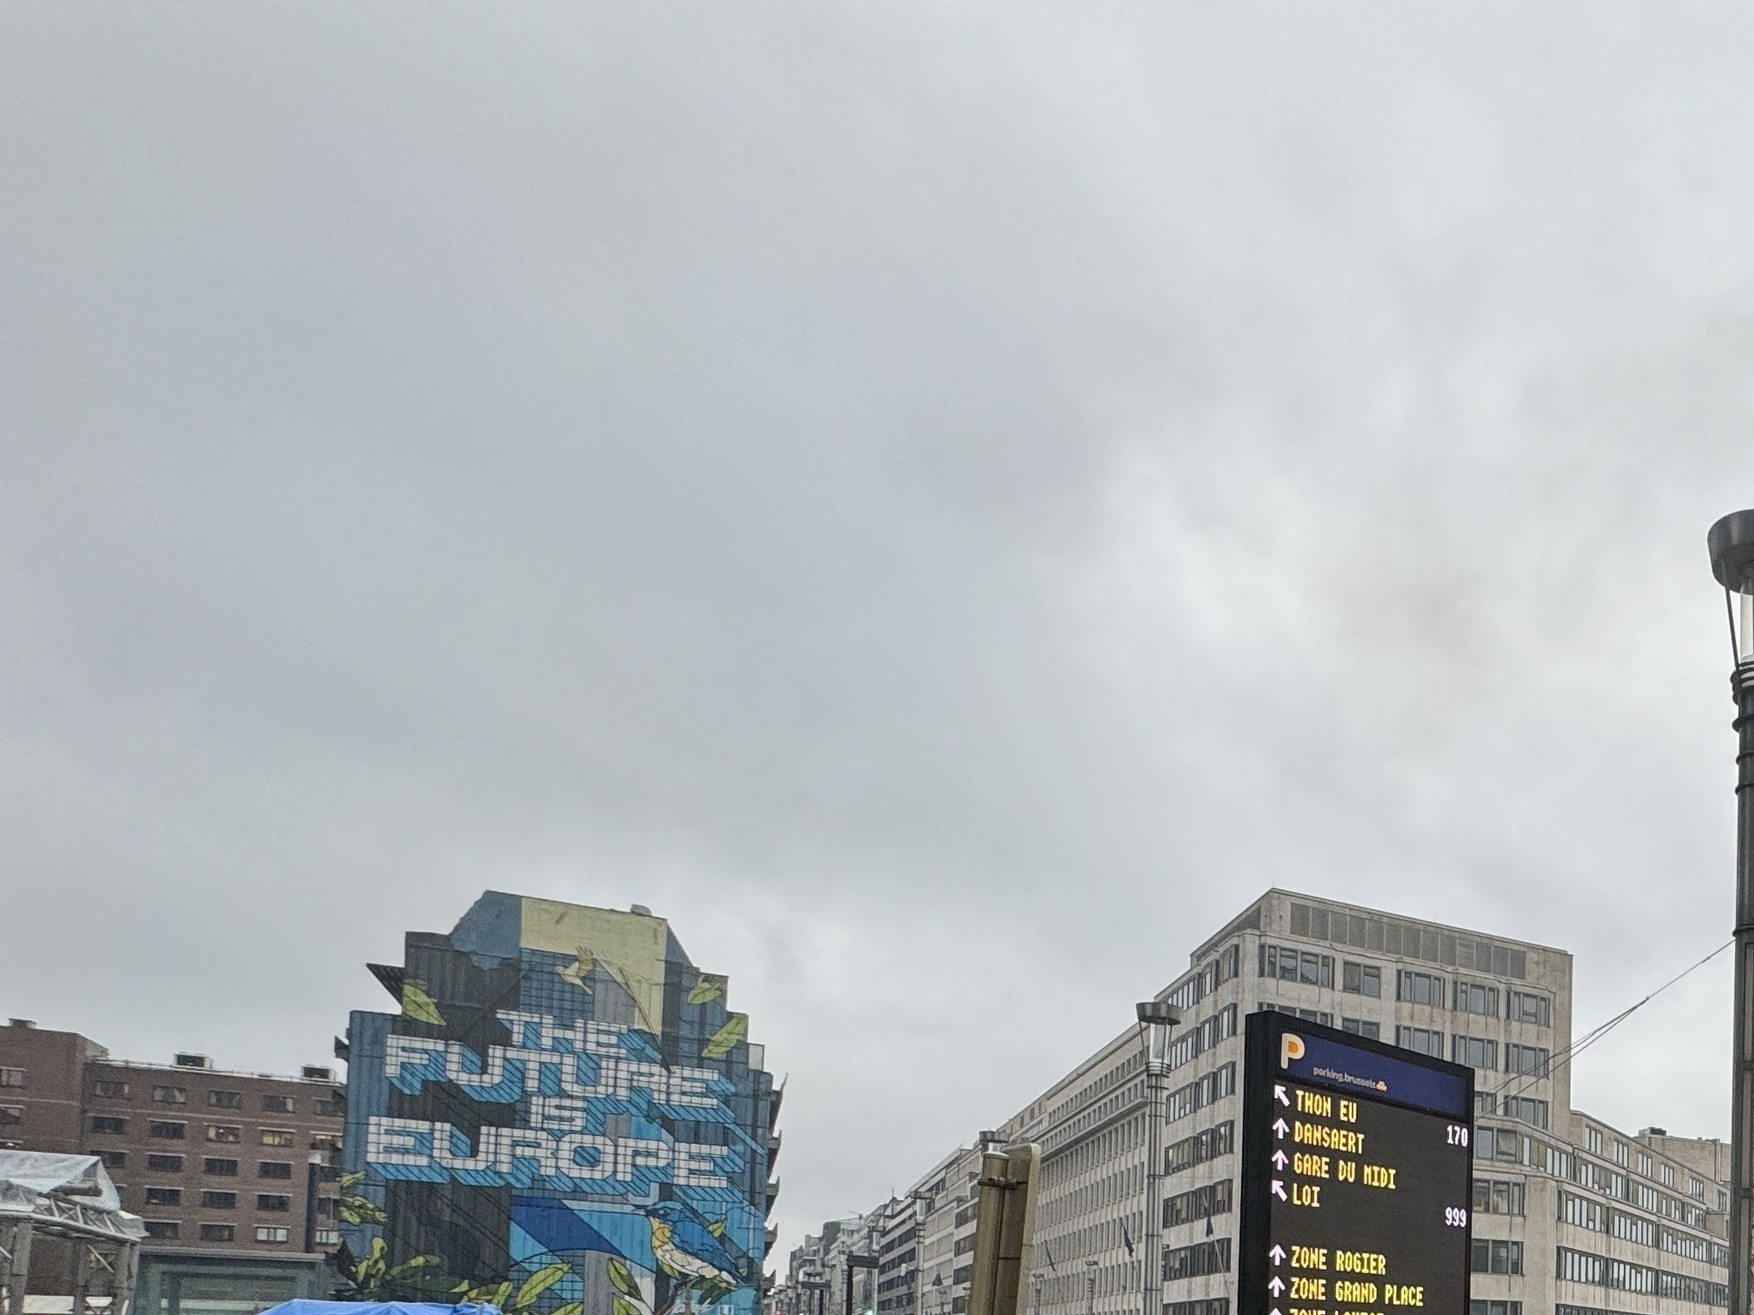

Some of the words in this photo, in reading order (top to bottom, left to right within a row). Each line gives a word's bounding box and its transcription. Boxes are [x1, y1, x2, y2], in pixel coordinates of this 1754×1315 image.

[496, 1009, 628, 1057] THE
[1281, 1033, 1305, 1069] P
[385, 1035, 719, 1108] FUTURE
[530, 1096, 587, 1131] IS
[1296, 1090, 1331, 1117] THON
[1340, 1100, 1357, 1123] EU
[1447, 1125, 1468, 1147] 170
[366, 1116, 728, 1187] EUROPE
[1295, 1121, 1364, 1154] DANSAERT
[1294, 1152, 1329, 1178] GARE
[1339, 1160, 1356, 1183] DU
[1364, 1164, 1396, 1189] MIDI
[1293, 1183, 1320, 1207] LOI
[1445, 1207, 1467, 1228] 999
[1291, 1246, 1327, 1270] ZONE
[1336, 1250, 1386, 1275] ROGIER
[1290, 1277, 1326, 1300] ZONE
[1335, 1281, 1377, 1303] GRAND
[1385, 1284, 1423, 1306] PLACE
